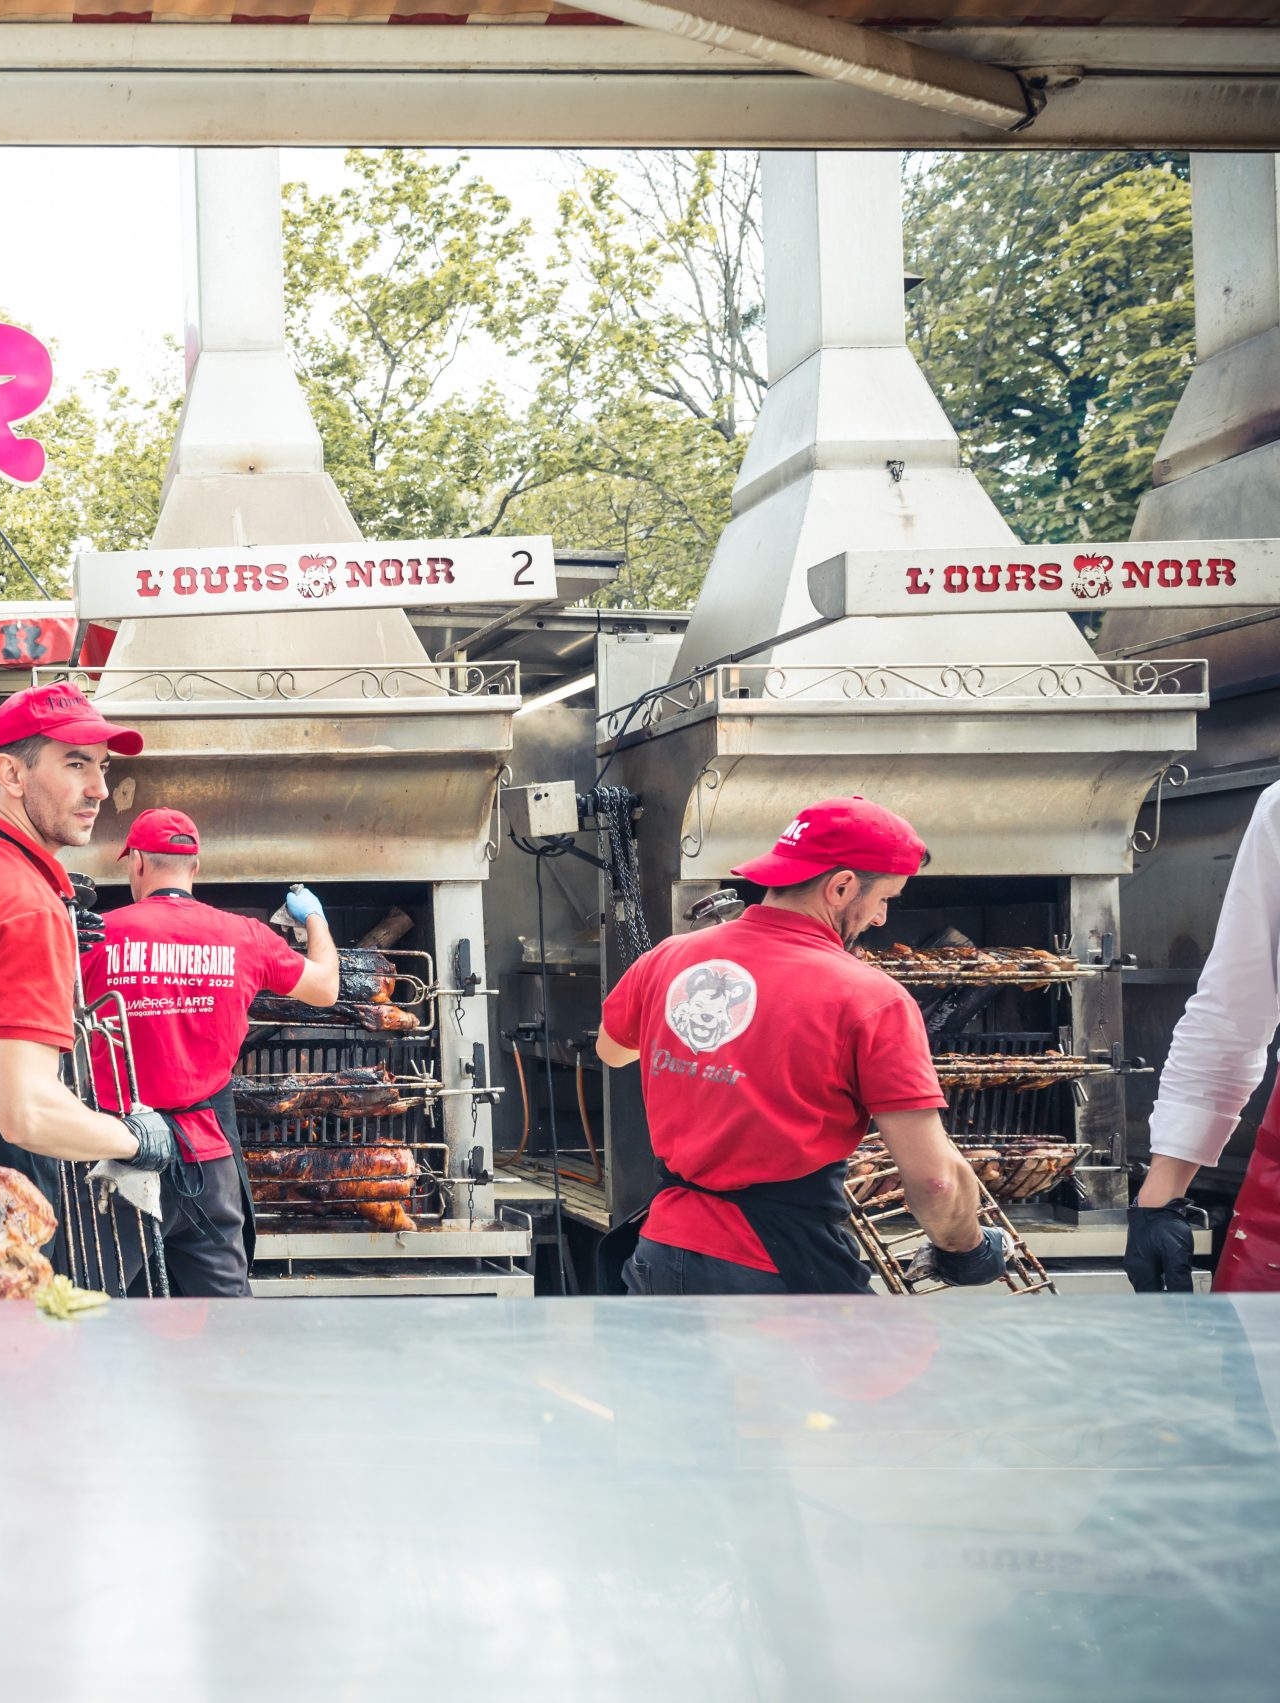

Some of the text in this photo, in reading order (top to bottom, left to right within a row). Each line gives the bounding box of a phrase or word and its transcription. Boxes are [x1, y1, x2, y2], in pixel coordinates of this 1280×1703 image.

[136, 549, 535, 598] L'OURS NOIR 2
[905, 557, 1238, 595] L'OURS NOIR
[105, 936, 236, 976] 70 ÈME ANNIVERSAIRE
[106, 975, 235, 988] FOIRE DE NANCY 2022
[127, 1010, 162, 1018] magazine
[184, 996, 215, 1007] ARTS
